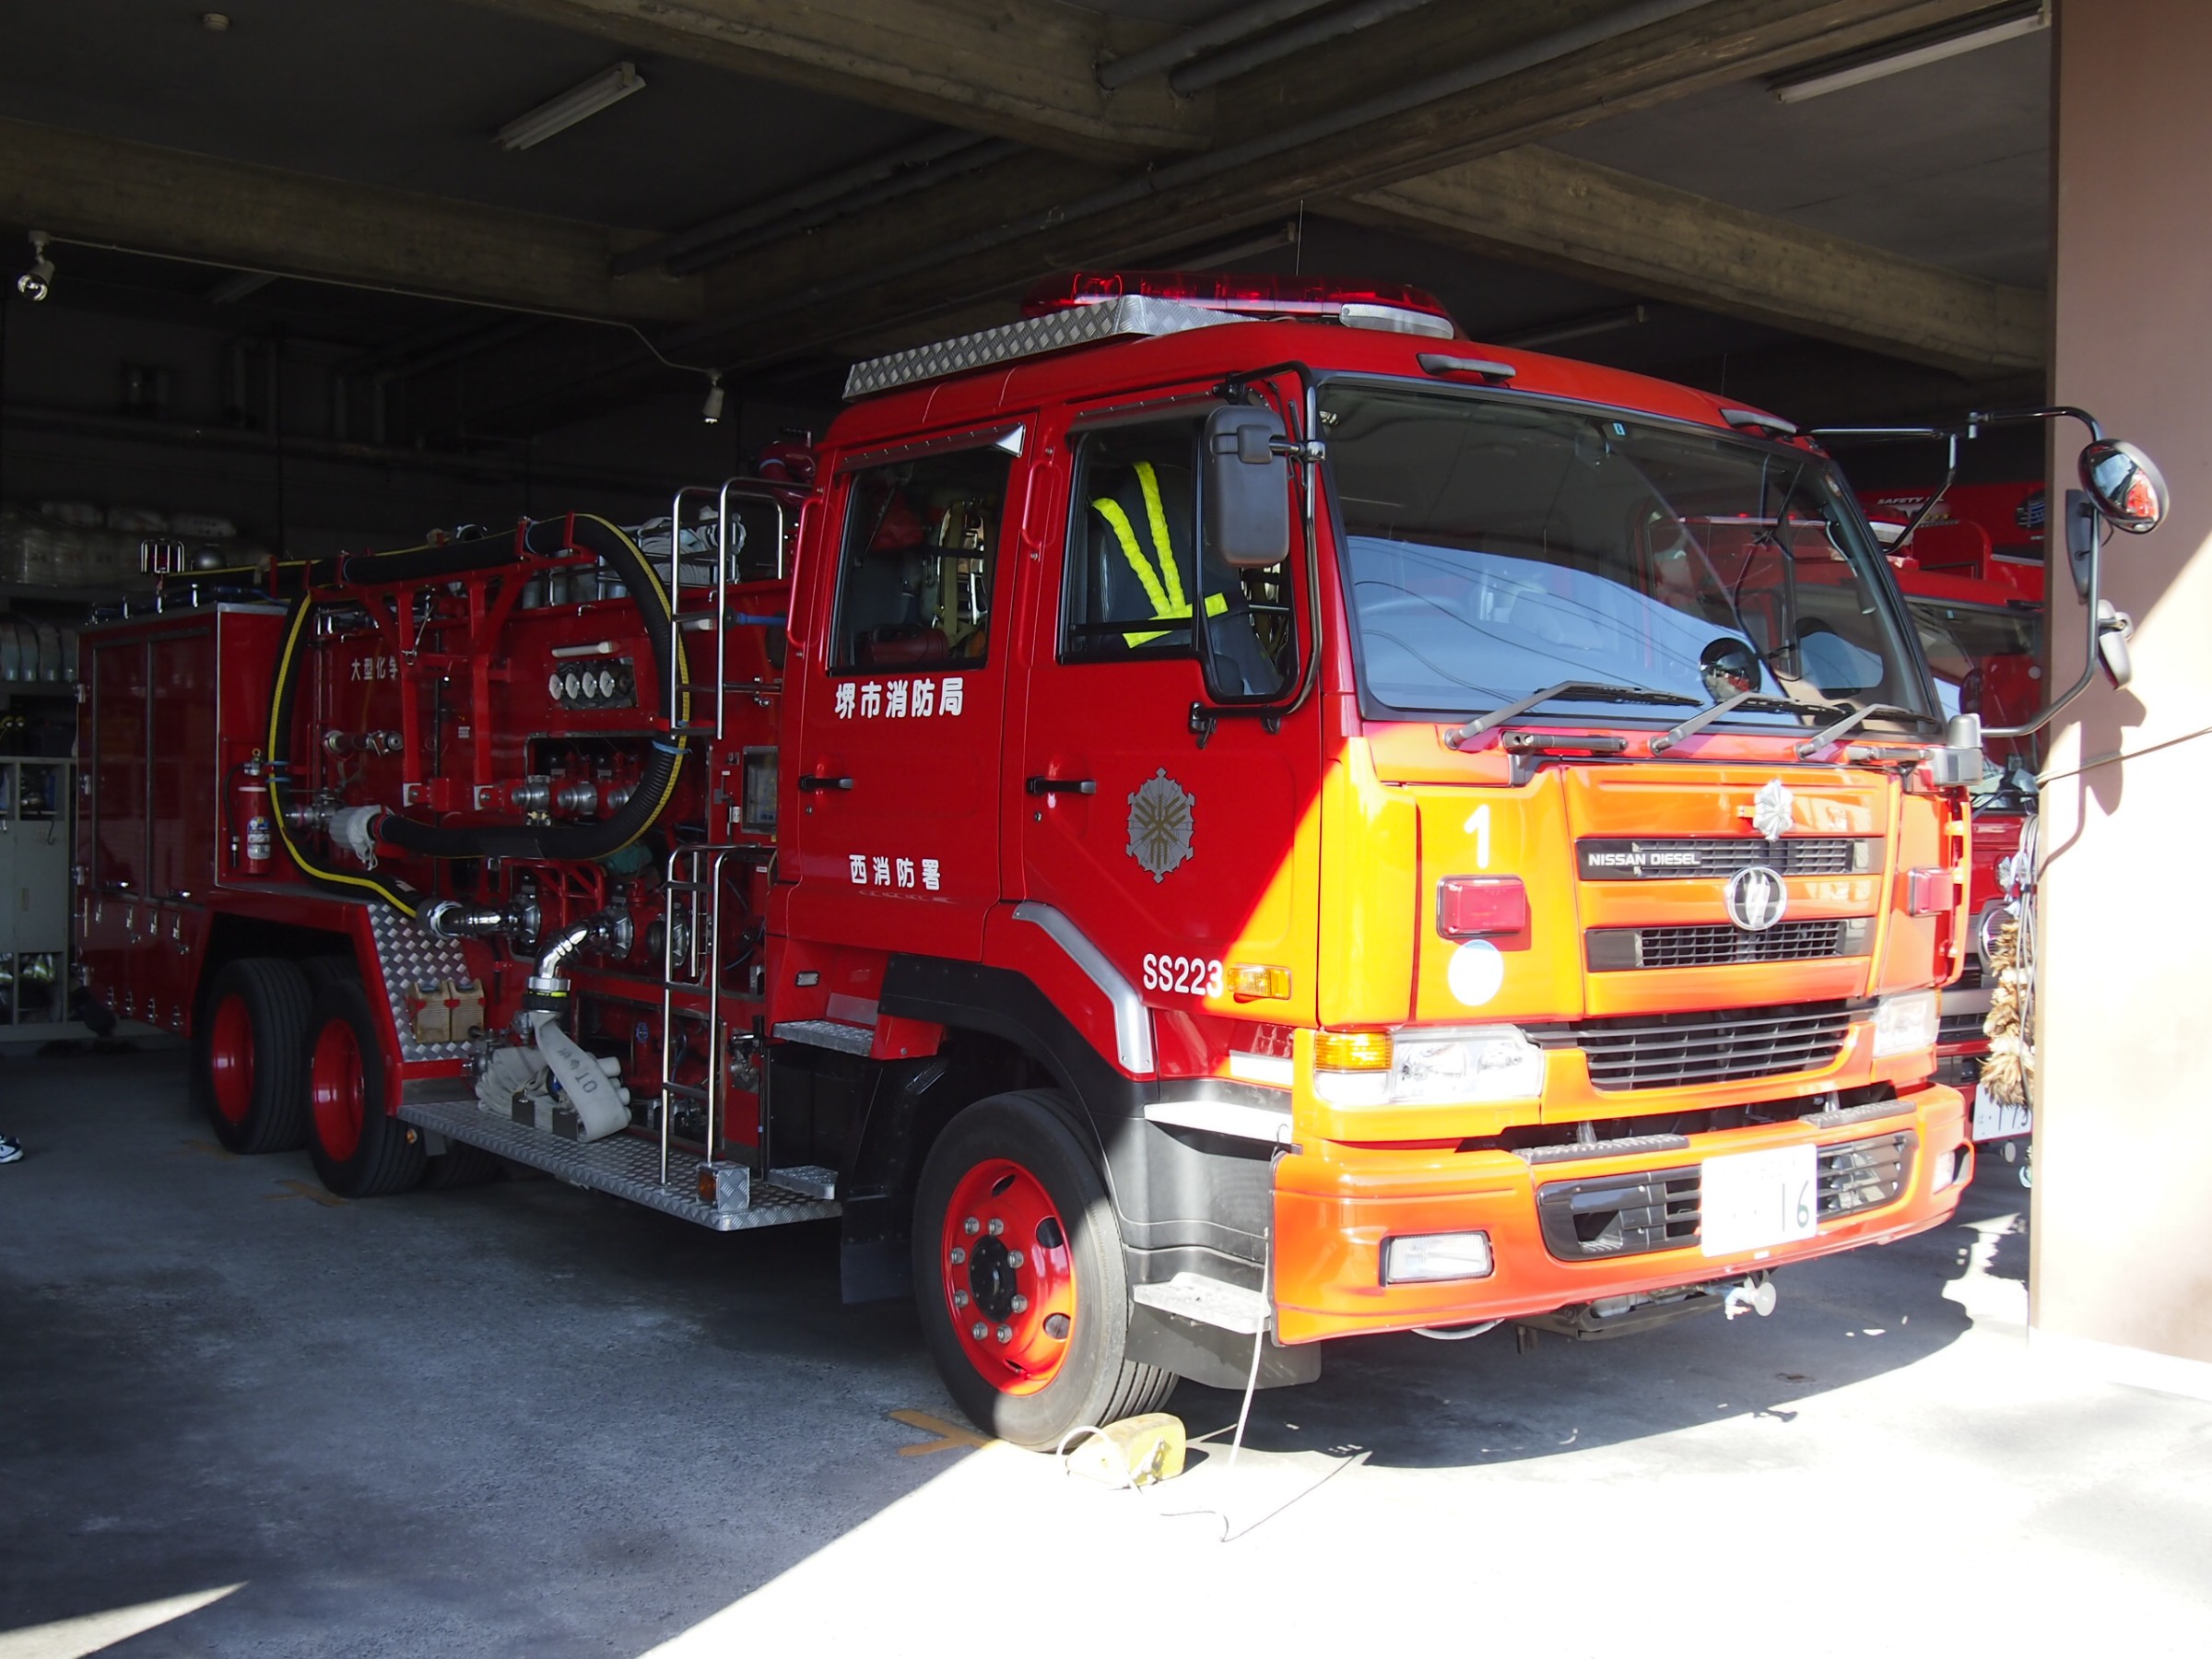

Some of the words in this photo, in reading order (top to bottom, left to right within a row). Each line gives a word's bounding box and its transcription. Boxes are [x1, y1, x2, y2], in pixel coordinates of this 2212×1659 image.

[1877, 497, 1924, 505] SAFETY
[834, 677, 964, 720] 堺市消防局
[1464, 804, 1490, 870] 1
[849, 854, 941, 891] 西消防署
[1588, 853, 1646, 866] NISSAN
[1650, 853, 1700, 865] DIESEL
[1143, 953, 1224, 999] SS223
